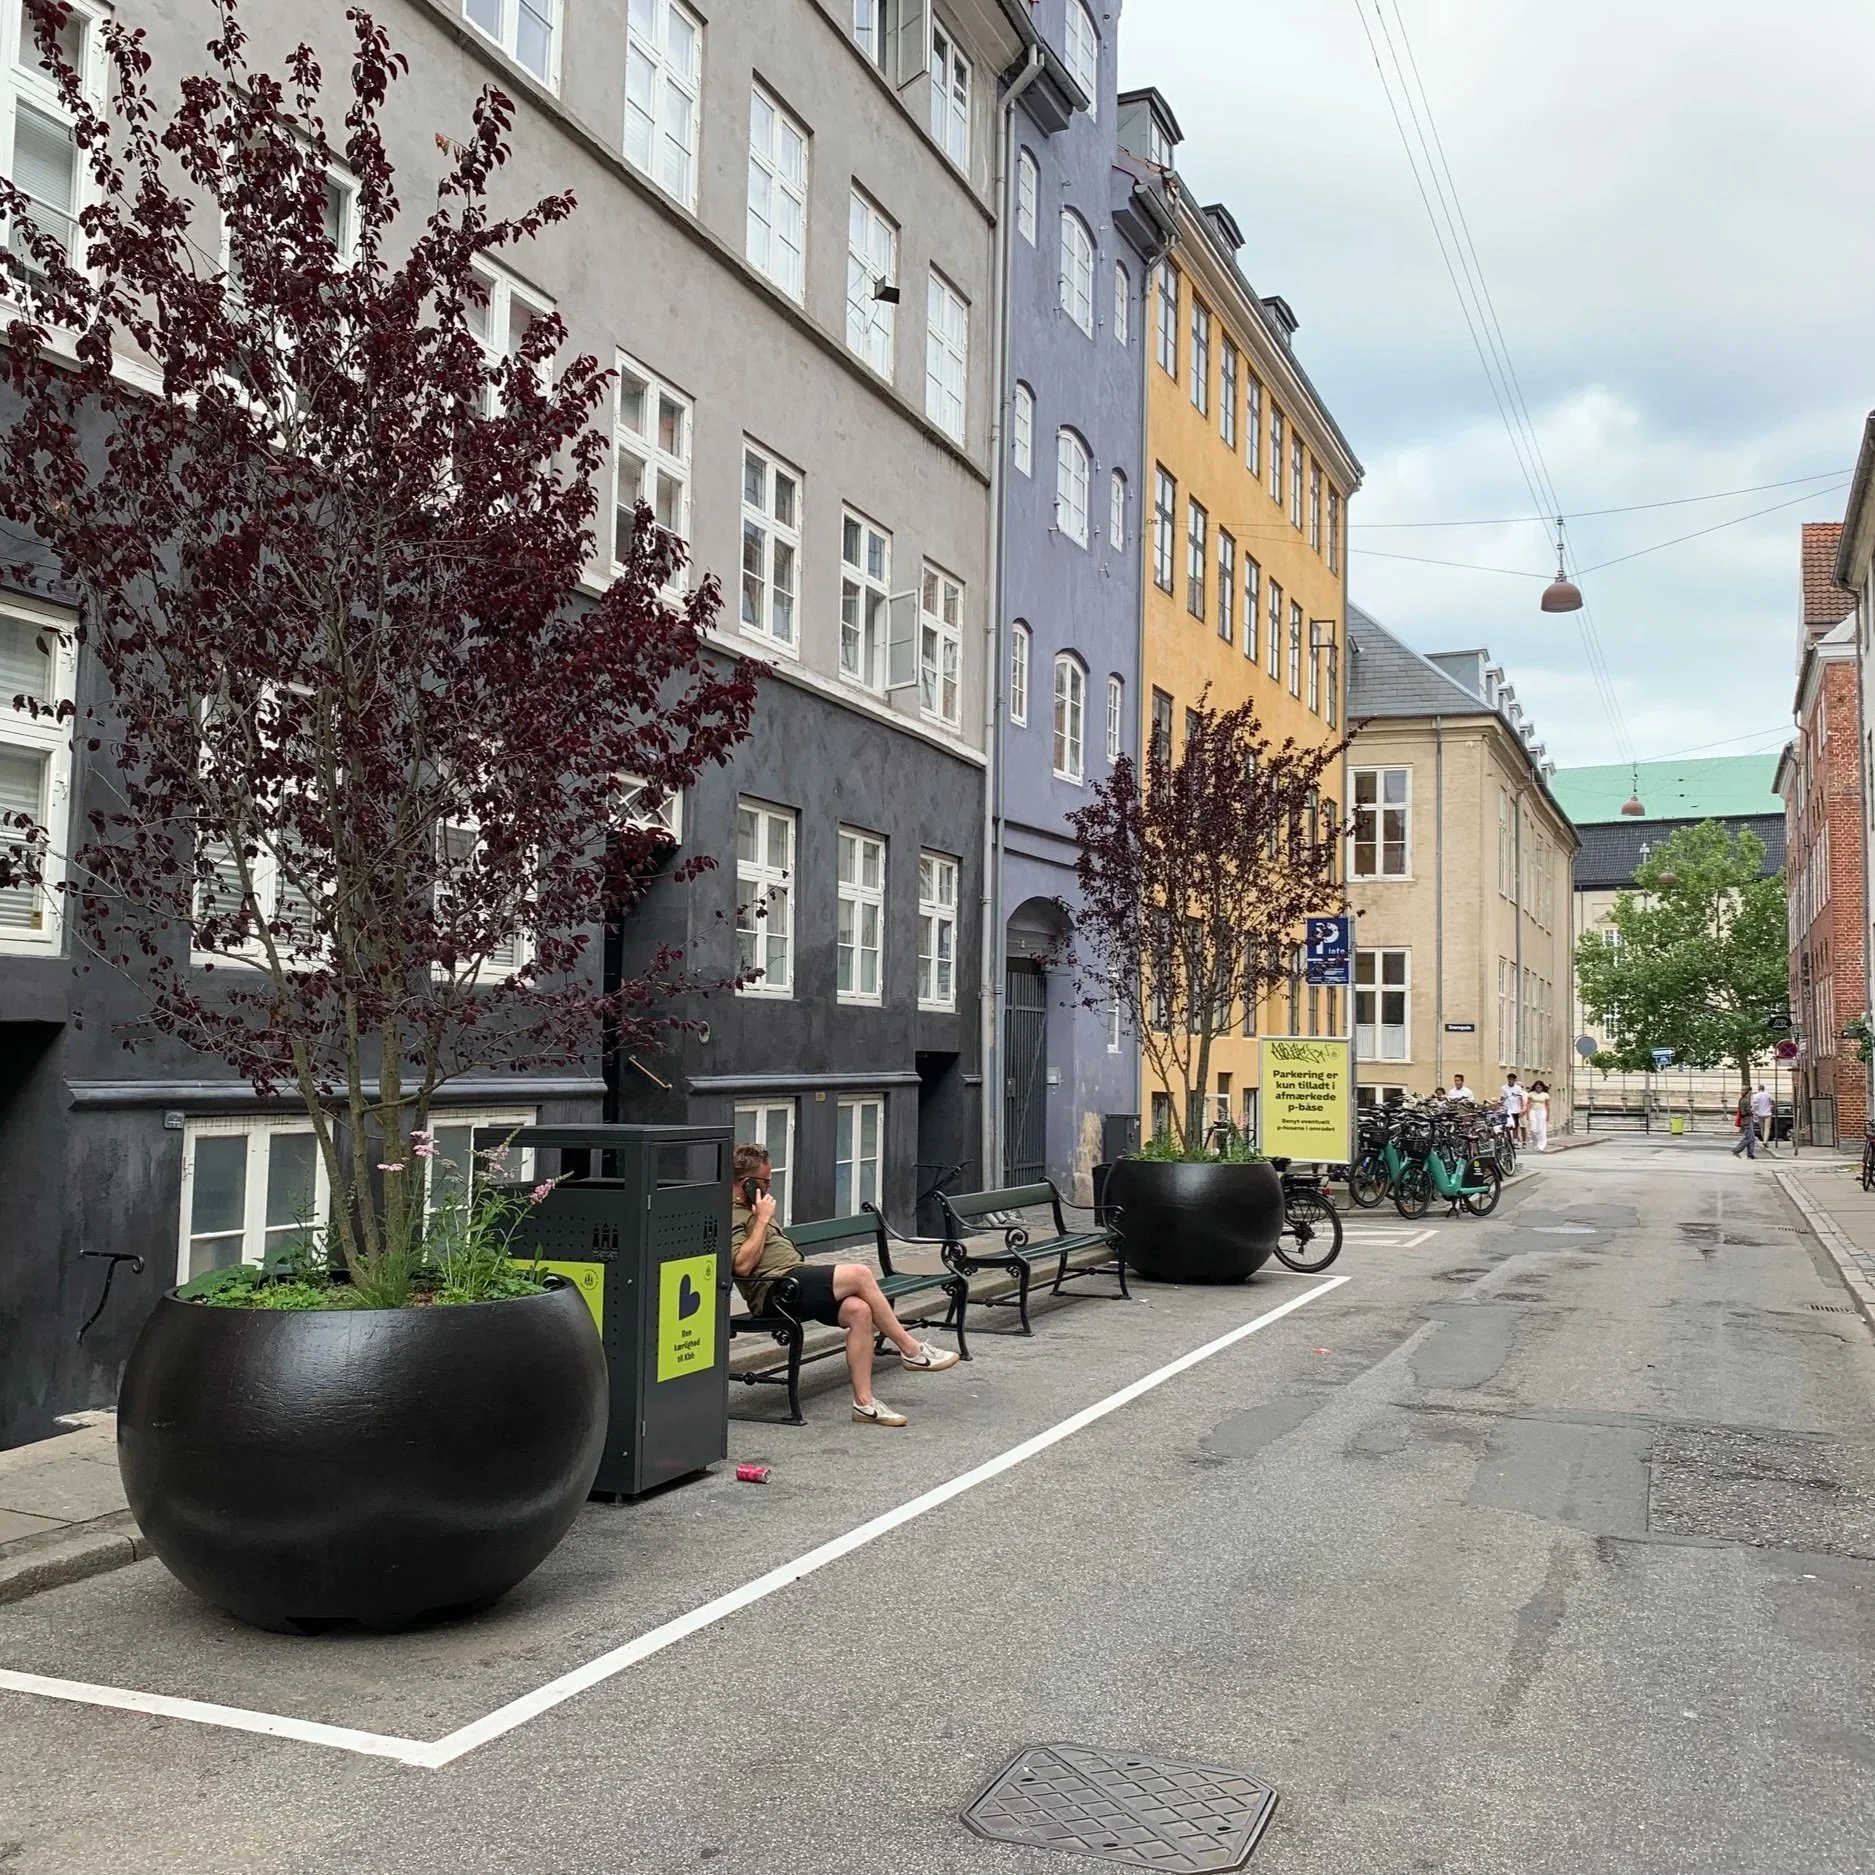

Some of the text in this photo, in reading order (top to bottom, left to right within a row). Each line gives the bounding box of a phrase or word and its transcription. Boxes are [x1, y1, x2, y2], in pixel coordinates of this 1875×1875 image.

[1273, 1070, 1324, 1081] Parkering
[1276, 1081, 1335, 1090] kun tilladt i
[1275, 1091, 1336, 1101] afmærkede
[1288, 1103, 1324, 1113] p-båse
